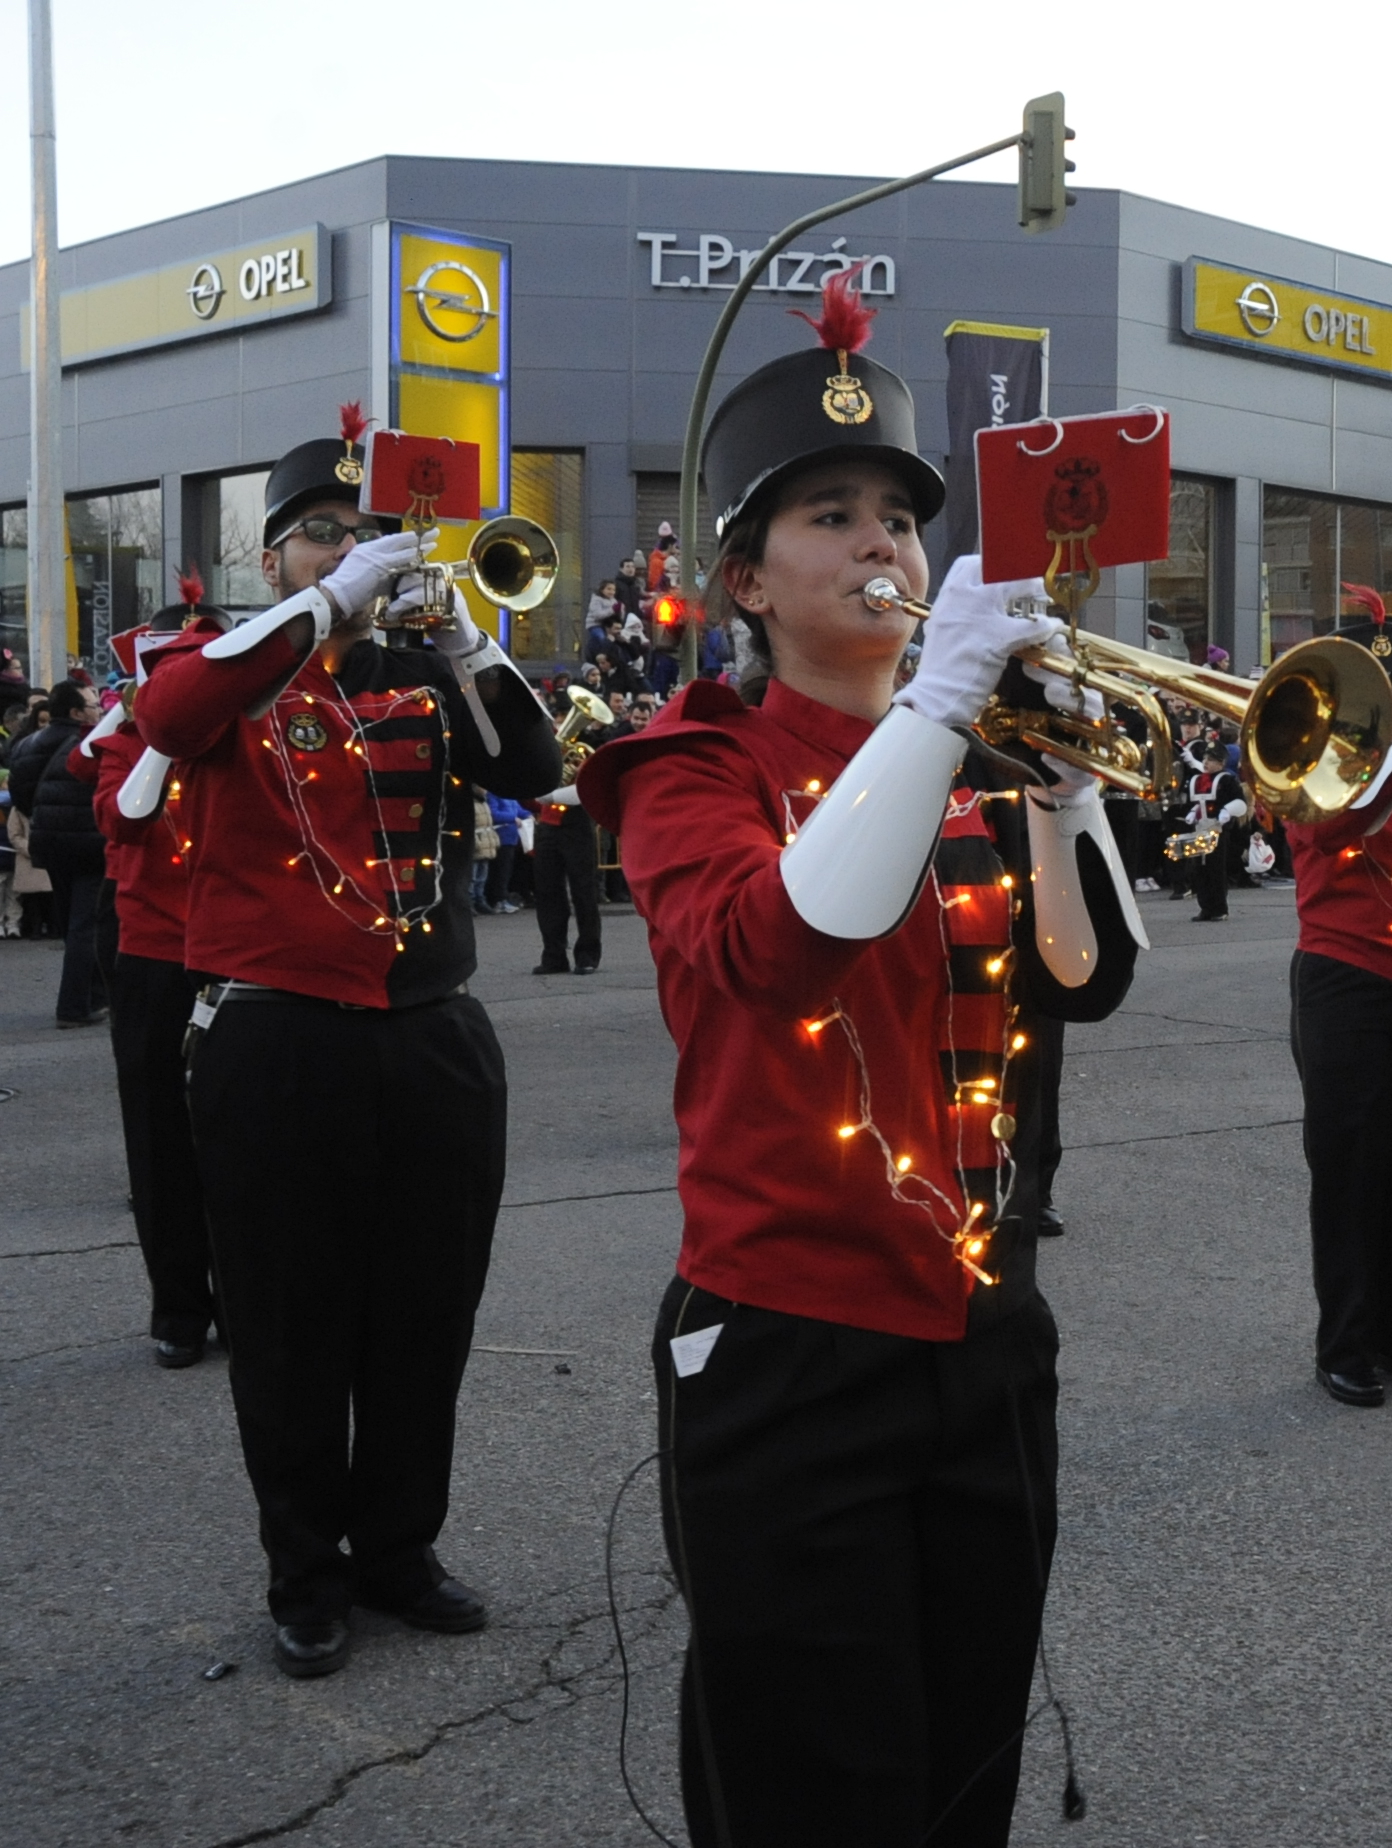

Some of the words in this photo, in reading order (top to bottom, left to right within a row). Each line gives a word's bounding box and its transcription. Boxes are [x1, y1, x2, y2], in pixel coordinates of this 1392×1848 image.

[239, 247, 308, 301] OPEL
[636, 231, 896, 295] T.Prizán
[1303, 303, 1377, 356] OPEL
